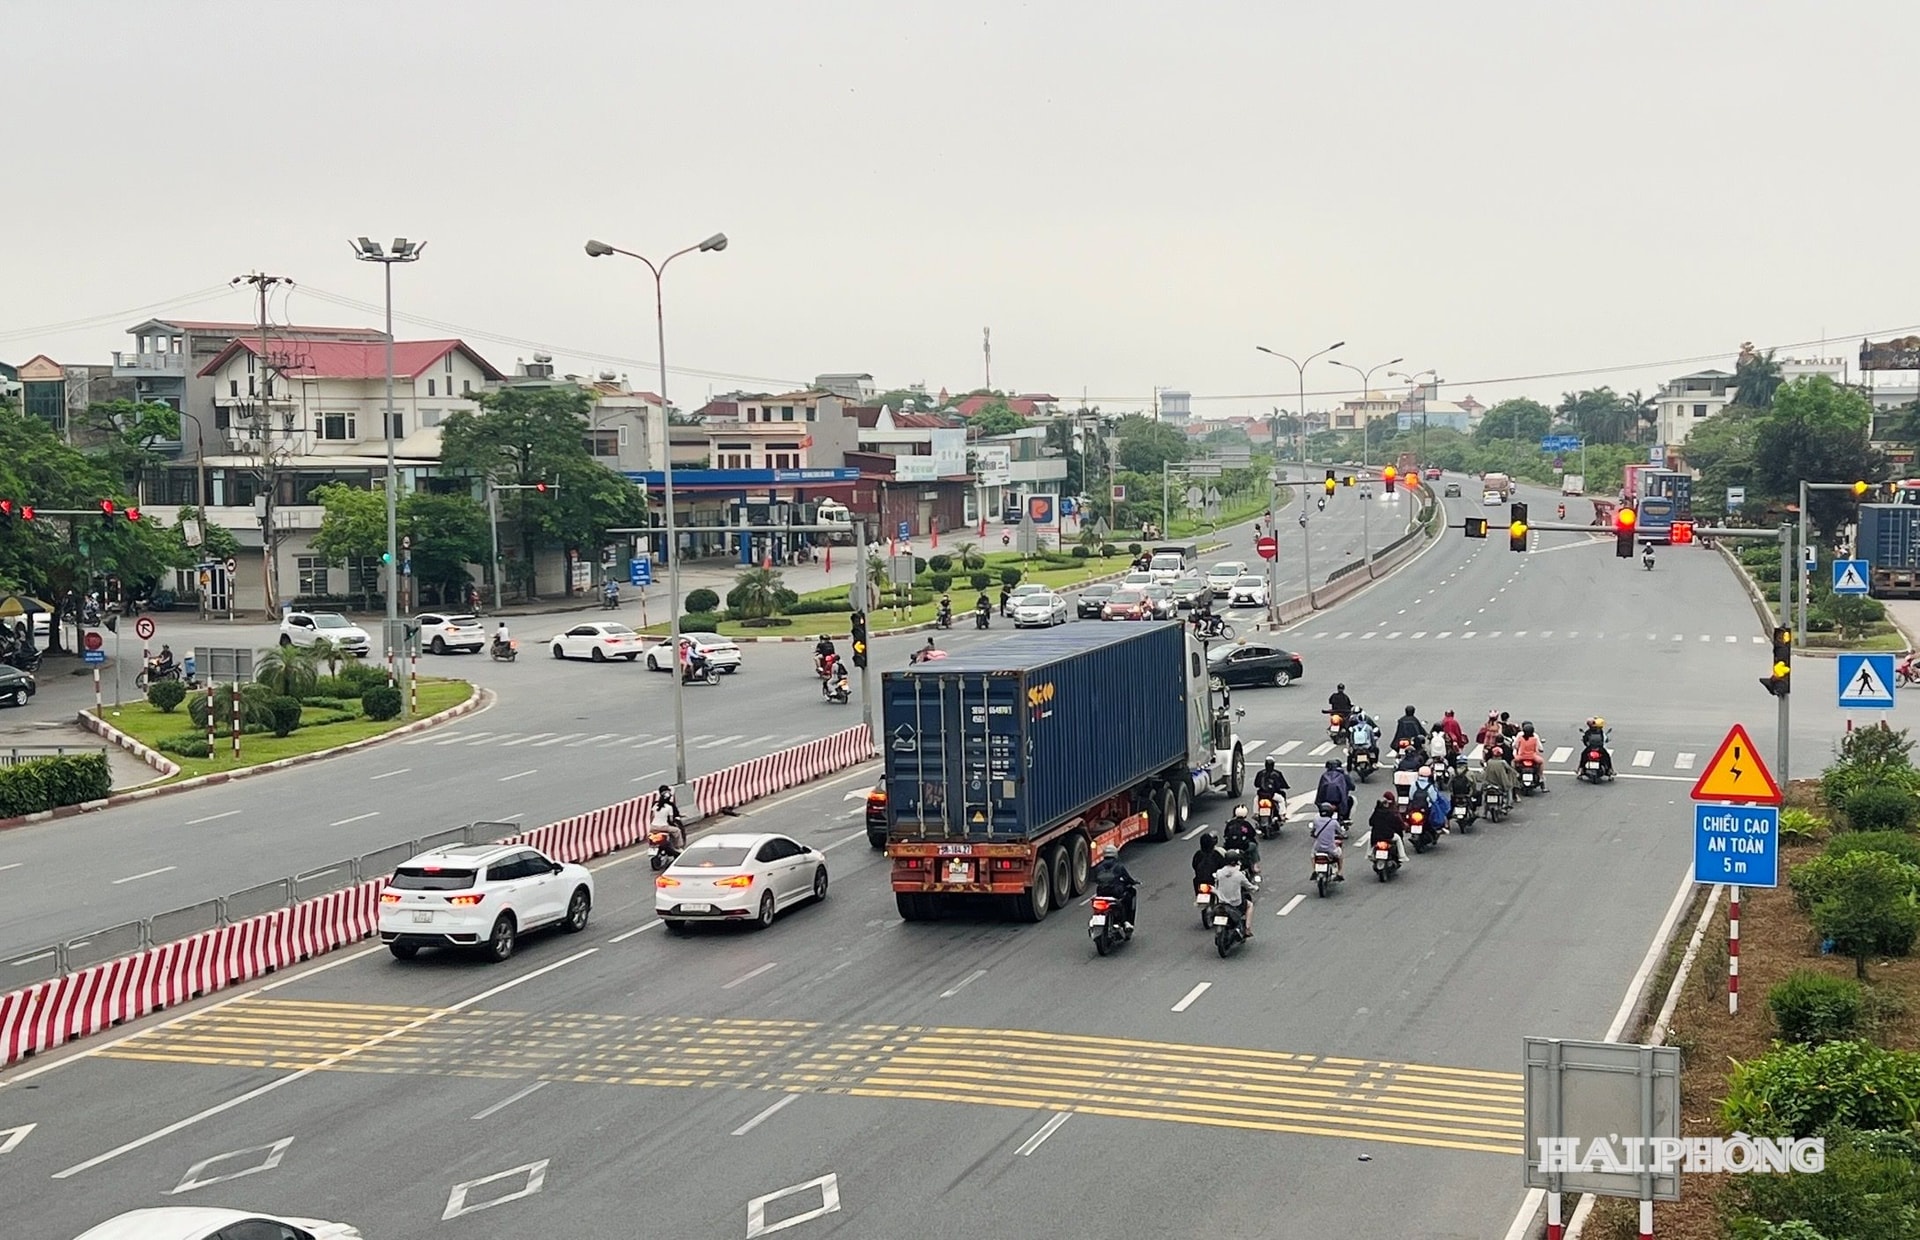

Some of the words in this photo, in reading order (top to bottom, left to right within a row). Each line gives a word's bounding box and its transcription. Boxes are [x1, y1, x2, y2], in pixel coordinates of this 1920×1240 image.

[1703, 813, 1739, 832] CHIỀU
[1744, 819, 1769, 834] CAO
[1708, 837, 1726, 852] AN
[1731, 835, 1764, 854] TOÀN
[1724, 857, 1732, 872] 5
[1735, 861, 1747, 873] m
